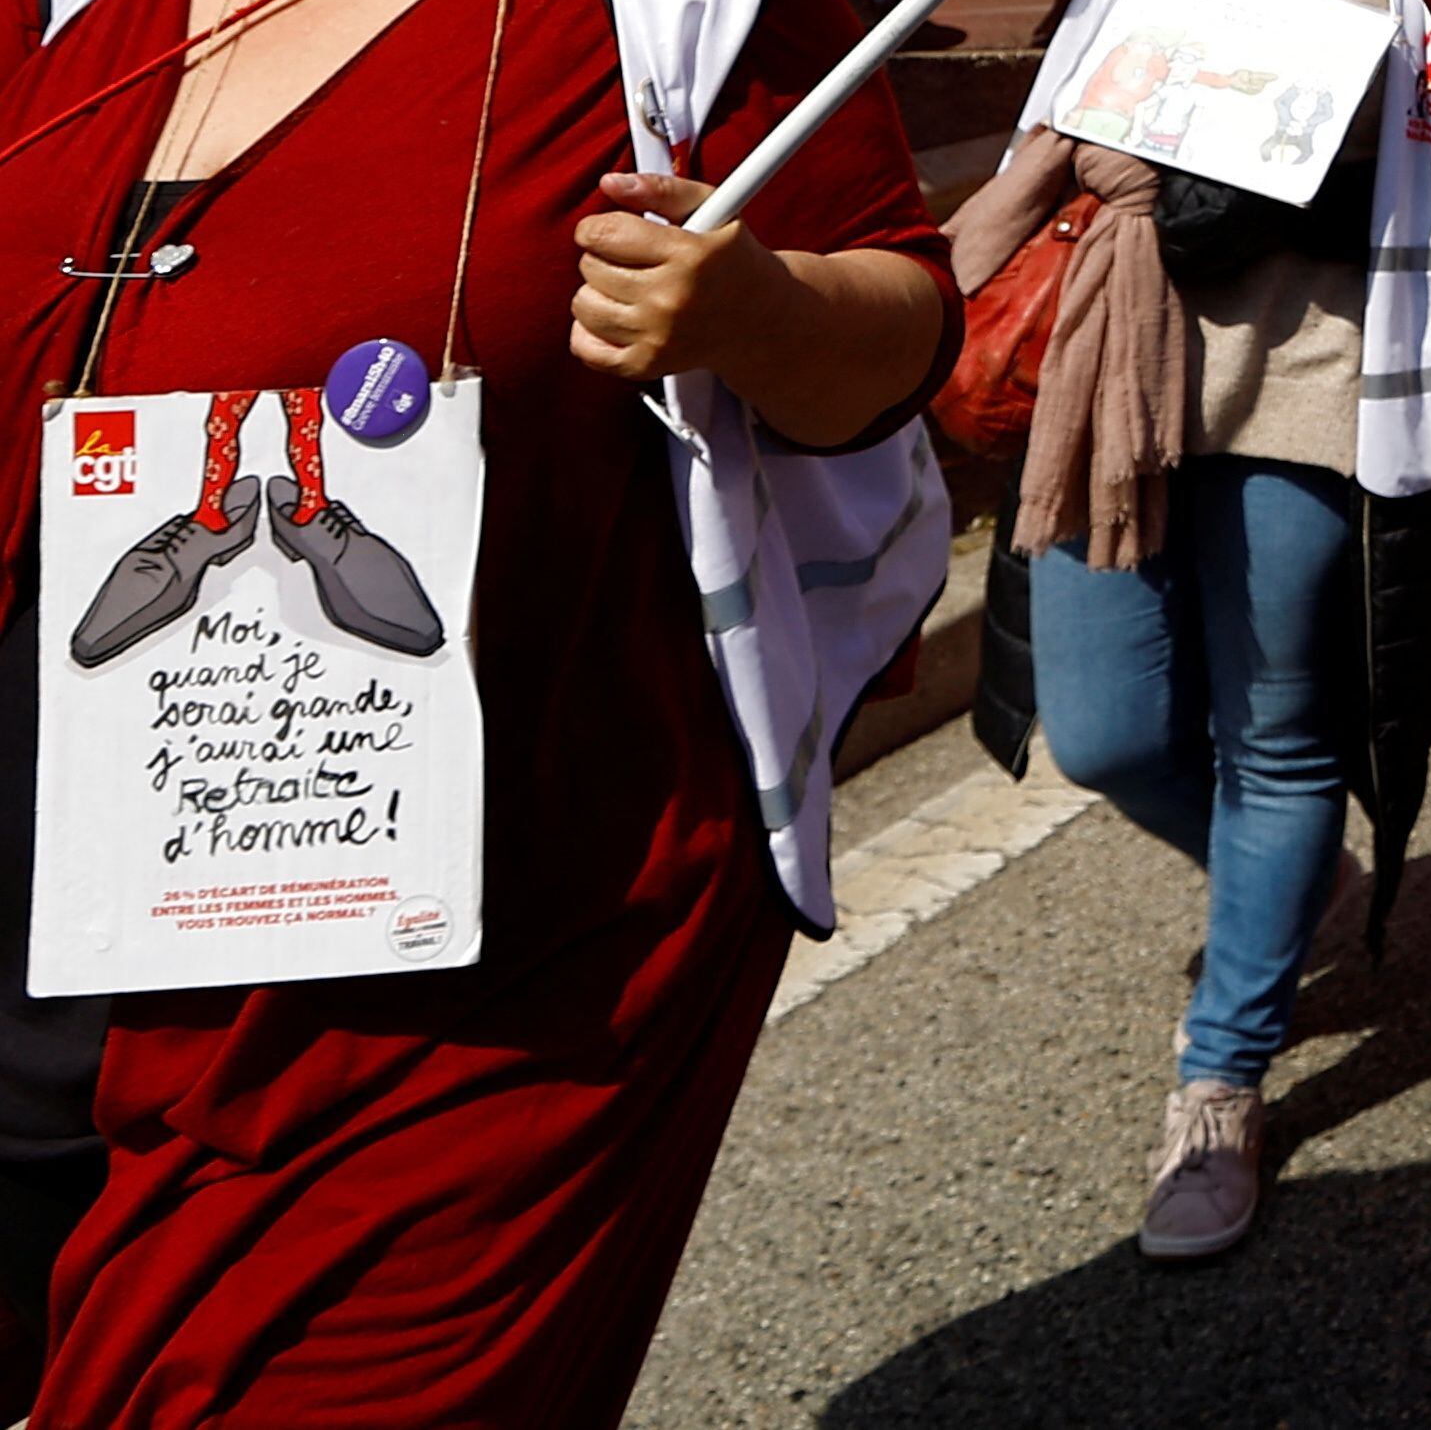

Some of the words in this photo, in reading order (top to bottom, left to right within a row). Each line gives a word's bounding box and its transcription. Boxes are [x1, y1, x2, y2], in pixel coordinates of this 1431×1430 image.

[75, 429, 123, 457] la
[74, 446, 138, 492] cgt
[191, 608, 281, 654] Moi,
[149, 653, 274, 710] quand
[283, 641, 327, 694] je
[151, 690, 265, 730] serai
[270, 678, 414, 741] grande,
[147, 729, 304, 792] j'aurai
[316, 722, 414, 755] une
[151, 905, 196, 918] ENTRE
[199, 902, 223, 915] LES
[225, 899, 285, 913] FEMMES
[288, 896, 304, 909] ET
[307, 895, 332, 908] LES
[258, 883, 277, 896] DE
[176, 918, 216, 931] VOUS
[218, 914, 280, 929] TROUVEZ
[306, 907, 366, 922] NORMAL
